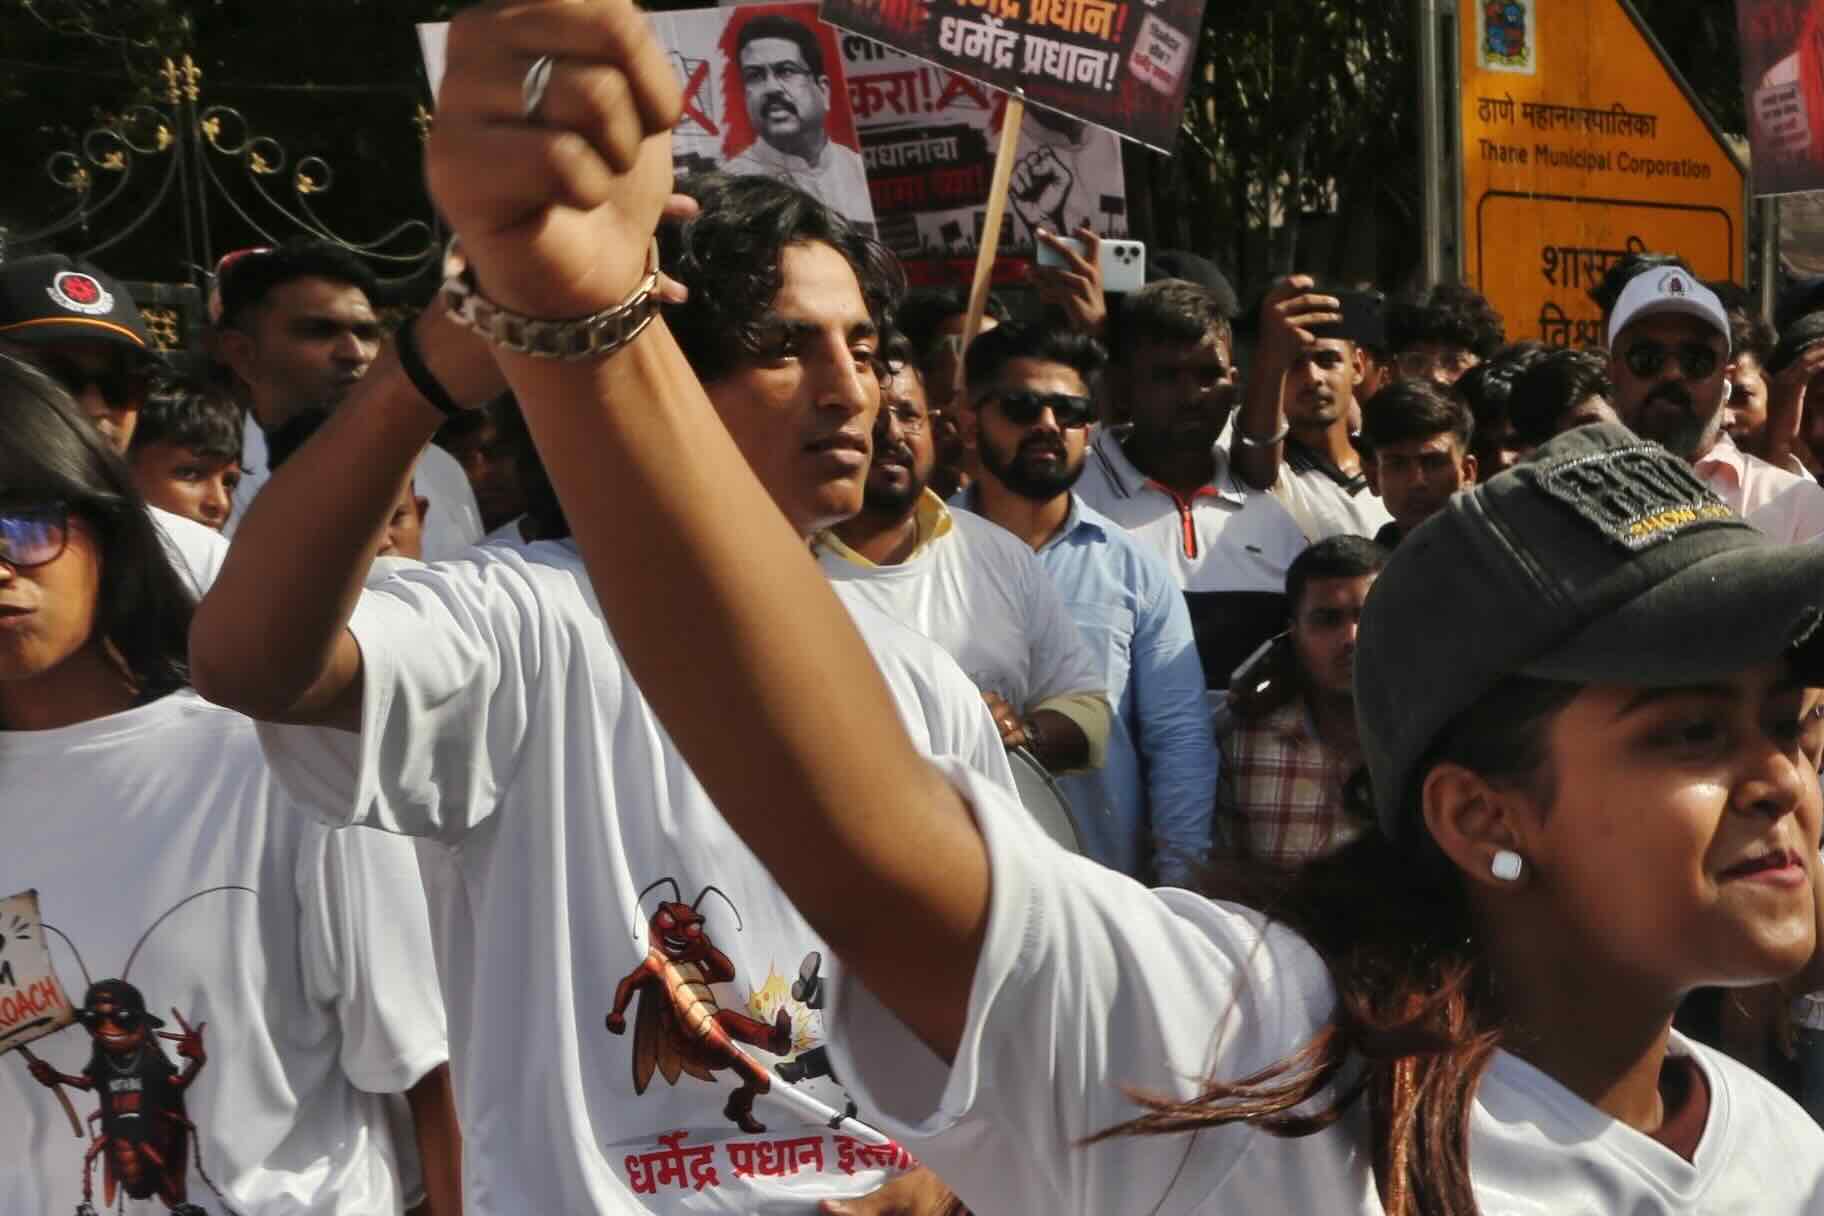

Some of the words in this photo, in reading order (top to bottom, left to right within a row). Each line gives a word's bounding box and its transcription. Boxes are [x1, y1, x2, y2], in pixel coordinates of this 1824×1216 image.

[938, 13, 1019, 69] धर्मेंद्र
[1021, 34, 1120, 91] प्रधान!
[1478, 92, 1515, 125] ठाणे
[1479, 138, 1529, 163] Thane
[1535, 143, 1611, 172] Municipal
[1616, 151, 1711, 179] Corporation
[624, 1131, 720, 1195] धर्मेंद्र
[726, 1137, 824, 1179] प्रधान
